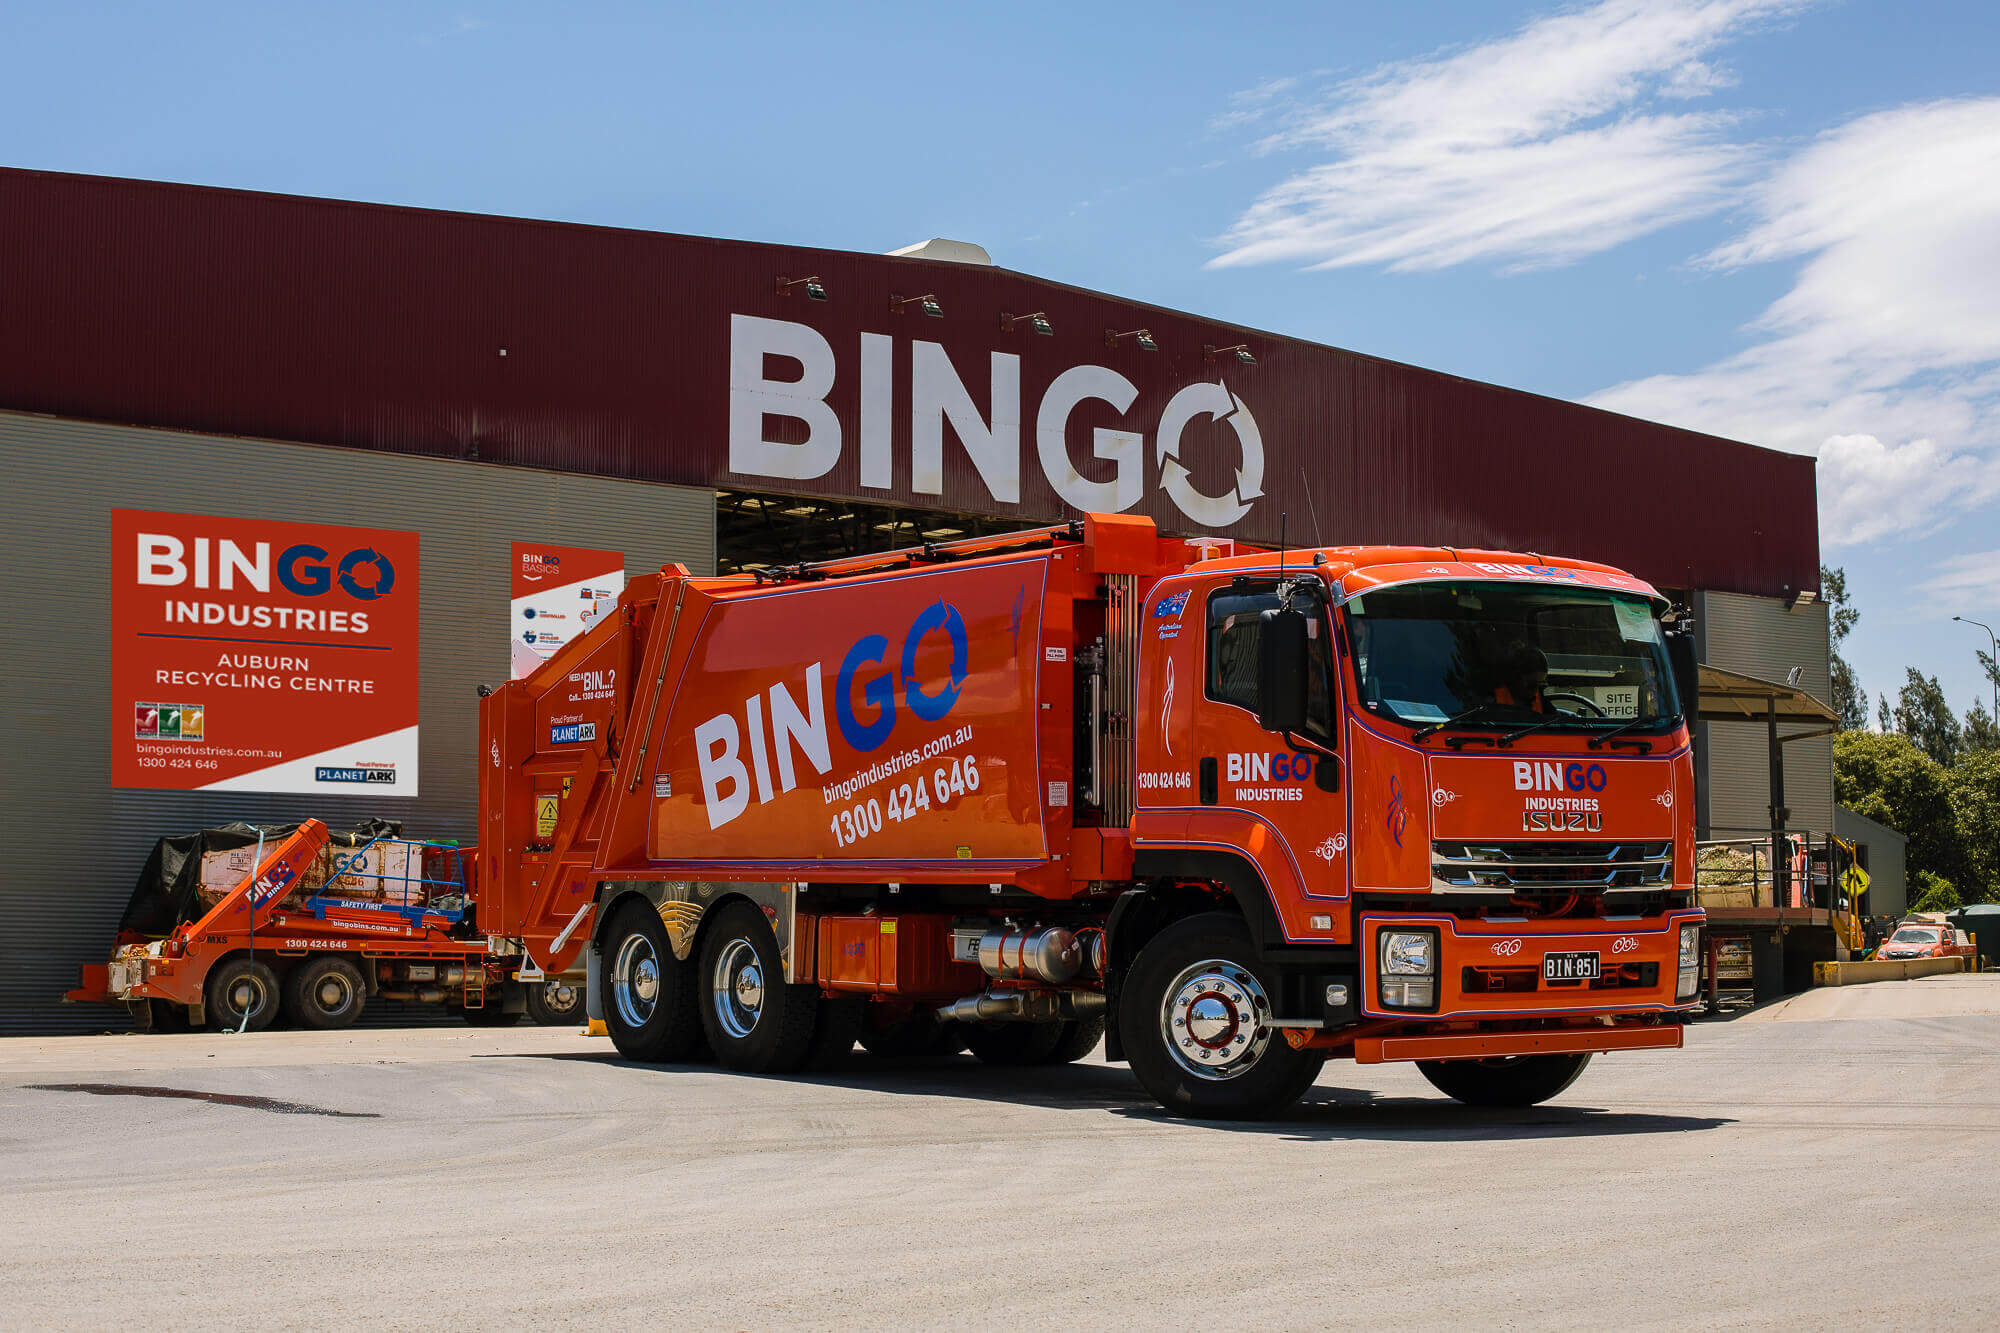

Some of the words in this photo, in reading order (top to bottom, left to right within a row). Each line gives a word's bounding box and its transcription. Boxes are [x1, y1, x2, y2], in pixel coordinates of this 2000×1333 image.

[729, 313, 1265, 527] BINGO
[137, 532, 395, 601] BINGO
[522, 562, 560, 575] BASICS
[523, 553, 560, 566] BINGO
[165, 600, 370, 634] INDUSTRIES
[217, 653, 310, 672] AUBURN
[156, 669, 281, 689] RECYCLING
[289, 677, 375, 694] CENTRE
[1606, 694, 1632, 703] SITE
[694, 596, 969, 831] BINGO
[552, 727, 578, 742] PLANET
[579, 726, 595, 740] ARK
[136, 743, 282, 758] bingoindustries.com.au
[137, 757, 166, 768] 1300
[170, 758, 191, 768] 424
[195, 759, 218, 769] 646
[822, 724, 973, 805] bingoindustries.com.au
[1227, 752, 1312, 782] BINGO
[318, 769, 365, 780] PLANET
[367, 771, 393, 781] ARK
[1138, 772, 1158, 789] 1300
[1159, 771, 1174, 789] 424
[1175, 771, 1191, 788] 646
[1513, 761, 1608, 792] BINGO
[831, 798, 882, 848] 1300
[887, 776, 930, 822] 424
[934, 754, 980, 804] 646
[1235, 787, 1304, 801] INDUSTRIES
[1525, 797, 1600, 811] INDUSTRIES
[1522, 811, 1603, 832] ISUZU
[265, 880, 285, 899] BINS
[340, 900, 365, 909] SAFETY
[364, 903, 383, 911] FIRST
[332, 920, 399, 932] bingobins.com.au
[286, 939, 308, 949] 1300
[309, 940, 328, 949] 424
[329, 940, 348, 949] 646
